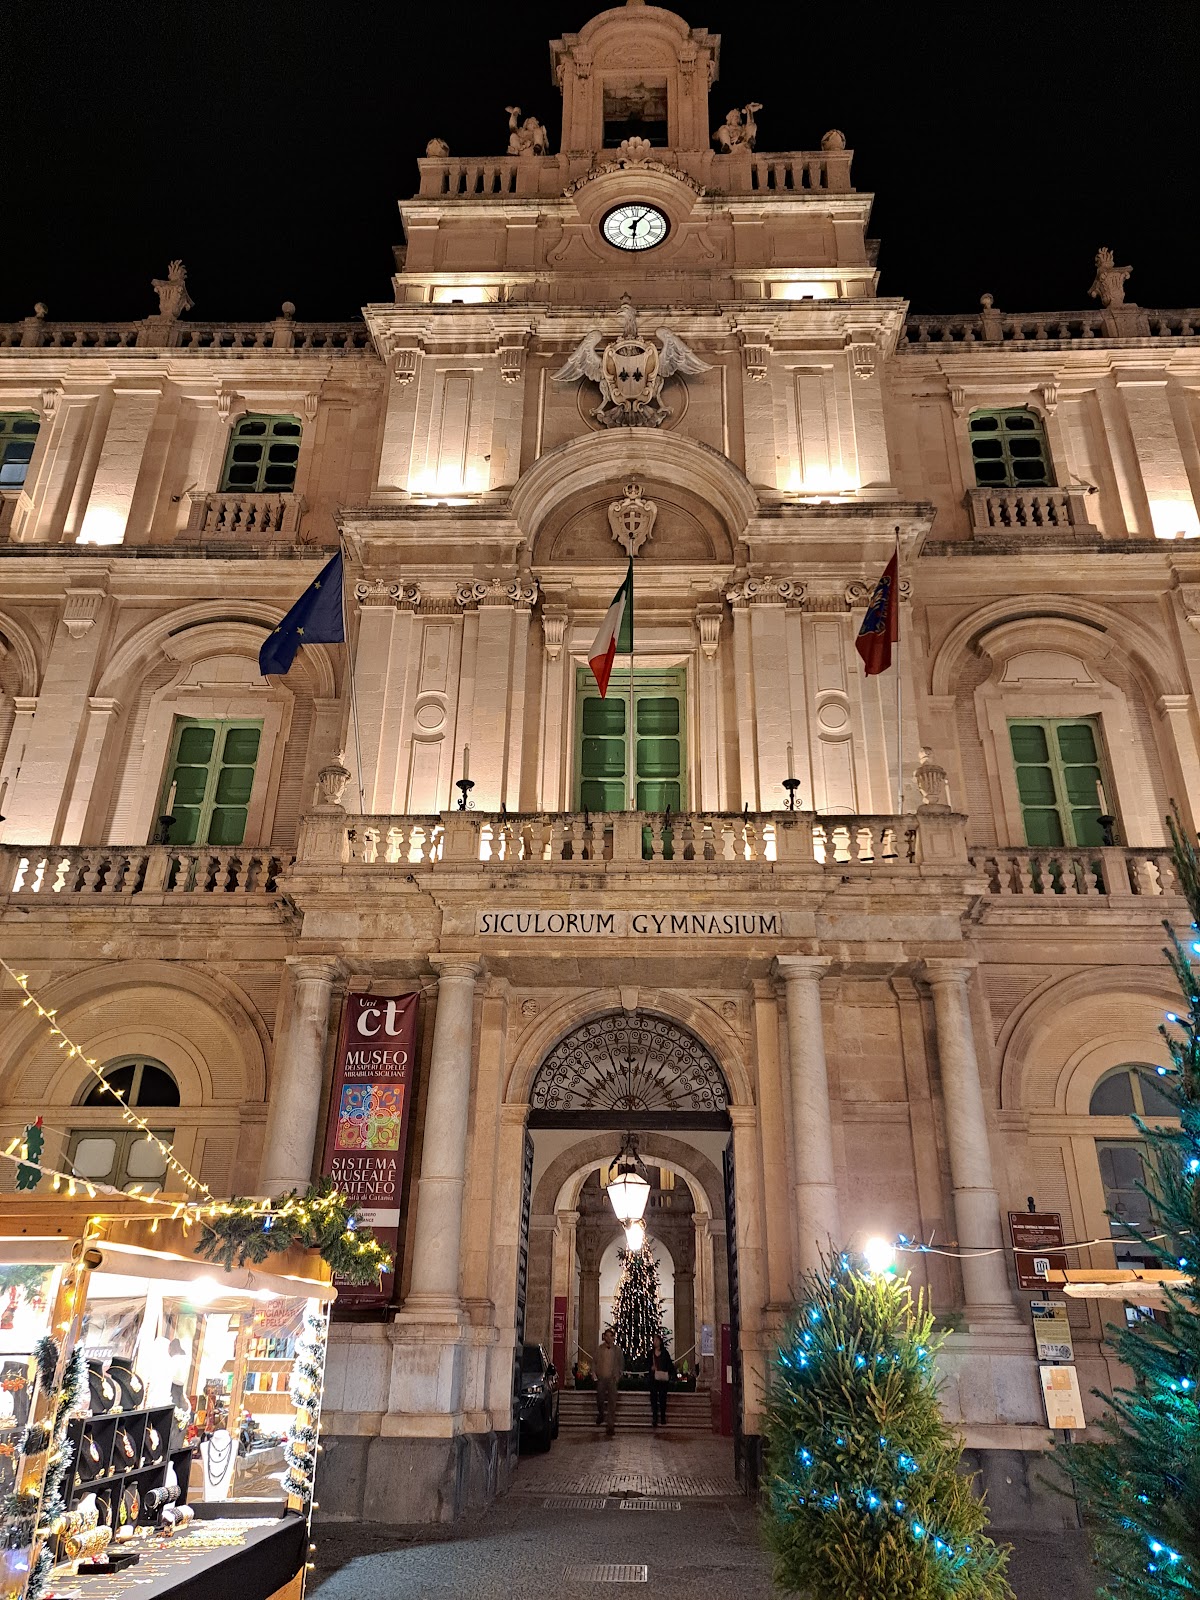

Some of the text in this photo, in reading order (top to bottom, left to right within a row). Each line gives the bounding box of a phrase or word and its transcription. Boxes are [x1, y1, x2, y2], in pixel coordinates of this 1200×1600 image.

[480, 913, 778, 935] SICULORUM GYMNASIUM
[359, 998, 377, 1008] Uni
[357, 1000, 404, 1036] ct
[346, 1050, 408, 1065] MUSEO
[332, 1157, 396, 1170] SISTEMA
[331, 1169, 396, 1182] MUSEALE
